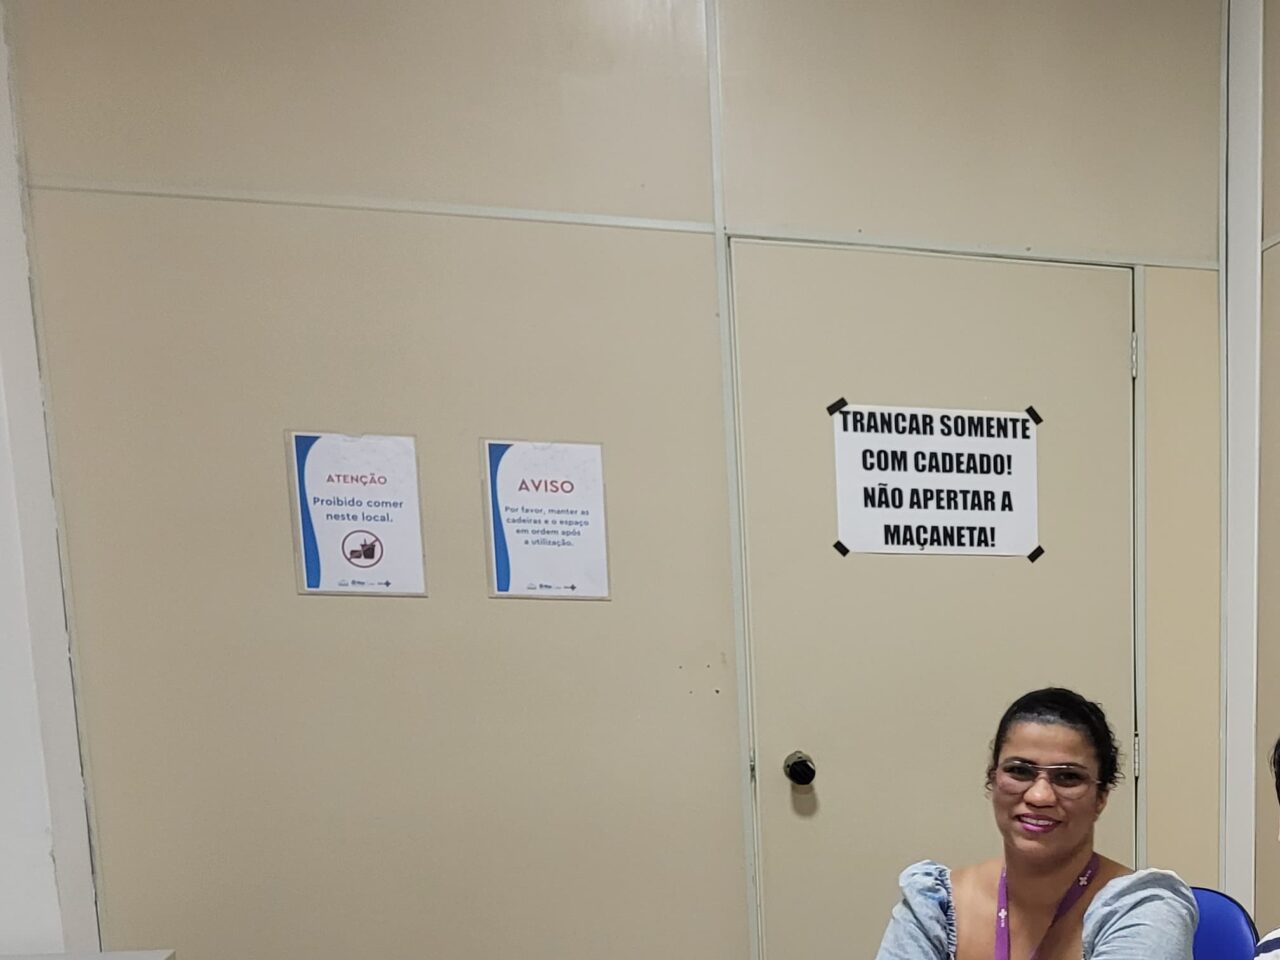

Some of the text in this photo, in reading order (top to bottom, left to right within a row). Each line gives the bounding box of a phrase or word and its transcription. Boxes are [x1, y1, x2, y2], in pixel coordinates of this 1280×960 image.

[839, 410, 1031, 440] TRANCAR SOMENTE
[862, 449, 1012, 476] COM CADEADO!
[326, 472, 387, 486] ATENÇÃO
[518, 478, 574, 494] AVISO
[313, 496, 403, 509] Proibido comer
[863, 482, 1014, 512] NÃO APERTAR A
[326, 511, 393, 522] neste local.
[521, 506, 546, 515] favor,
[506, 516, 541, 524] cadeiras
[884, 524, 995, 551] MAÇANETA!
